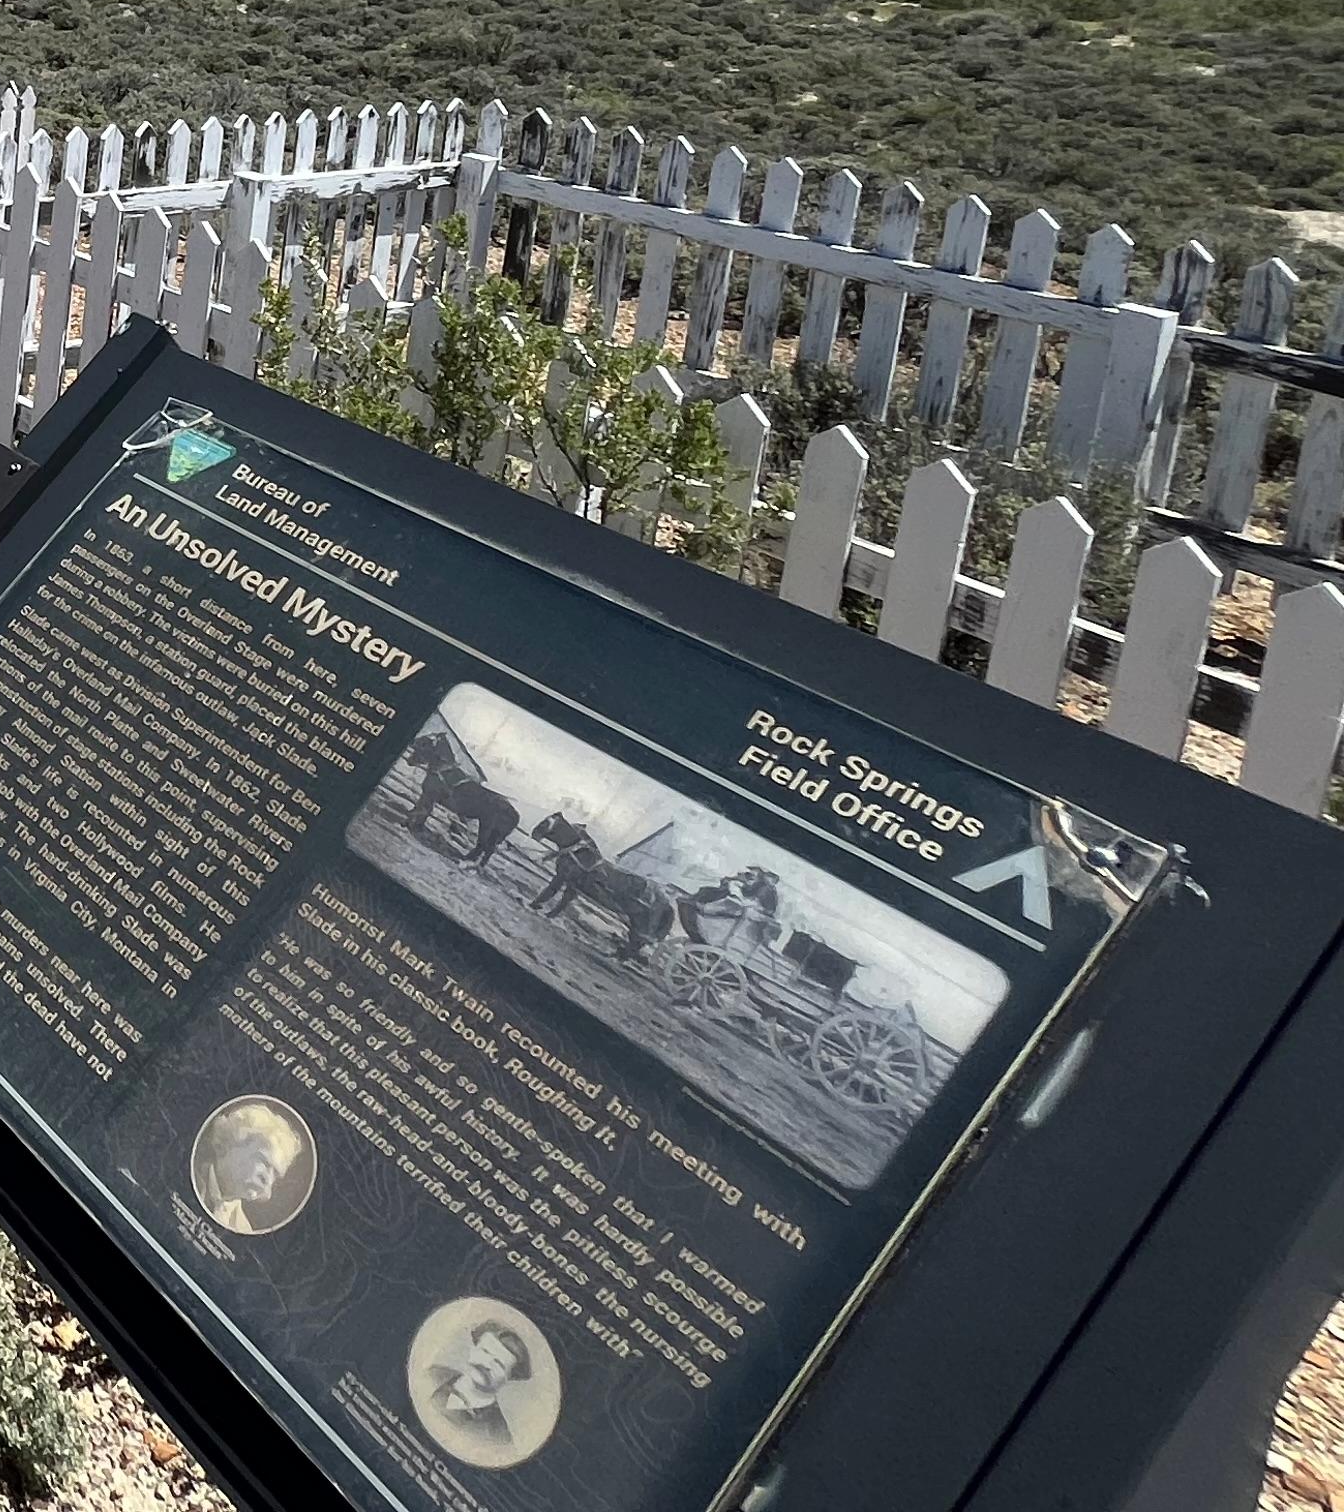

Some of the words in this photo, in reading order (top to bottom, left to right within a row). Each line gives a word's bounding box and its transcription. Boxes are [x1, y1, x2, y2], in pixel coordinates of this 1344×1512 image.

[214, 483, 267, 518] Land
[262, 507, 399, 586] Management
[231, 462, 301, 507] Bureau
[301, 500, 331, 517] of
[36, 583, 55, 600] for
[52, 595, 72, 613] the
[71, 609, 103, 634] crime
[101, 630, 119, 645] on
[118, 638, 139, 658] the
[137, 650, 195, 695] infamous
[194, 690, 239, 727] outlaw,
[241, 721, 276, 748] Jack
[275, 741, 318, 778] Slade.
[47, 571, 84, 599] James
[84, 592, 142, 640] Thompson,
[154, 640, 197, 672] station
[194, 667, 238, 700] guard,
[235, 693, 286, 727] placed
[283, 720, 308, 743] the
[307, 734, 354, 772] blame
[59, 557, 95, 585] during
[101, 584, 147, 618] robbery.
[148, 610, 172, 632] The
[171, 626, 216, 659] victims
[215, 653, 247, 680] were
[246, 671, 294, 706] buried
[289, 701, 310, 718] on
[310, 712, 340, 736] this
[338, 728, 366, 754] hill.
[68, 543, 134, 585] passengers
[134, 582, 152, 597] on
[153, 592, 175, 610] the
[176, 606, 234, 645] Overland
[233, 640, 272, 670] Stage
[275, 666, 310, 692] were
[311, 689, 385, 736] murdered
[82, 527, 96, 542] In
[159, 575, 192, 599] short
[199, 597, 253, 634] distance
[260, 632, 294, 659] from
[302, 656, 337, 688] here,
[350, 687, 396, 719] seven
[105, 493, 148, 528] An
[144, 512, 289, 603] Unsolved
[281, 586, 425, 683] Mystery
[6, 617, 61, 661] Halladay's
[62, 656, 115, 697] Overland
[112, 691, 143, 717] Mail
[142, 712, 201, 761] Company.
[204, 755, 220, 773] In
[225, 768, 261, 804] 1862,
[265, 798, 307, 833] Slade
[19, 604, 50, 631] Slade
[49, 626, 80, 652] came
[79, 646, 108, 670] west
[106, 665, 123, 680] as
[121, 673, 171, 713] Division
[170, 706, 269, 780] Superintendent
[268, 772, 292, 794] for
[290, 787, 321, 816] Ben
[737, 744, 830, 802] Field
[831, 791, 943, 861] Office
[745, 709, 835, 766] Rock
[838, 755, 984, 837] Springs
[0, 908, 49, 956] murders
[49, 954, 81, 984] near
[80, 980, 111, 1015] here
[113, 1012, 143, 1043] was
[7, 843, 21, 861] in
[23, 856, 67, 902] Virginia
[69, 899, 98, 931] City,
[99, 925, 158, 983] Montana
[160, 978, 177, 999] in
[13, 820, 36, 846] The
[37, 842, 118, 918] hard-drinking
[120, 914, 159, 952] Slade
[163, 951, 192, 980] was
[2, 969, 24, 994] the
[23, 991, 58, 1025] dead
[53, 1019, 87, 1057] have
[86, 1053, 113, 1082] not
[25, 961, 84, 1021] unsolved.
[89, 1018, 127, 1062] There
[297, 902, 342, 941] Slade
[342, 932, 360, 955] in
[359, 947, 388, 975] his
[388, 972, 450, 1022] classic
[449, 1014, 498, 1064] book,
[502, 1057, 596, 1131] Roughing
[311, 882, 385, 944] Humorist
[389, 939, 434, 980] Mark
[441, 974, 494, 1023] Twain
[499, 1022, 603, 1099] recounted
[605, 1094, 641, 1129] his
[647, 1129, 743, 1205] meeting
[753, 1202, 806, 1251] with
[217, 1003, 274, 1052] mothers
[272, 1051, 296, 1067] of
[291, 1064, 316, 1089] the
[315, 1086, 396, 1156] mountains
[396, 1154, 466, 1214] terrified
[463, 1211, 508, 1249] their
[506, 1249, 582, 1316] children
[233, 986, 255, 1001] of
[248, 997, 274, 1022] the
[272, 1019, 327, 1071] outlaws,
[330, 1066, 357, 1092] the
[355, 1089, 589, 1285] raw-head-and-bloody-bones
[594, 1286, 629, 1318] the
[628, 1317, 712, 1388] nursing
